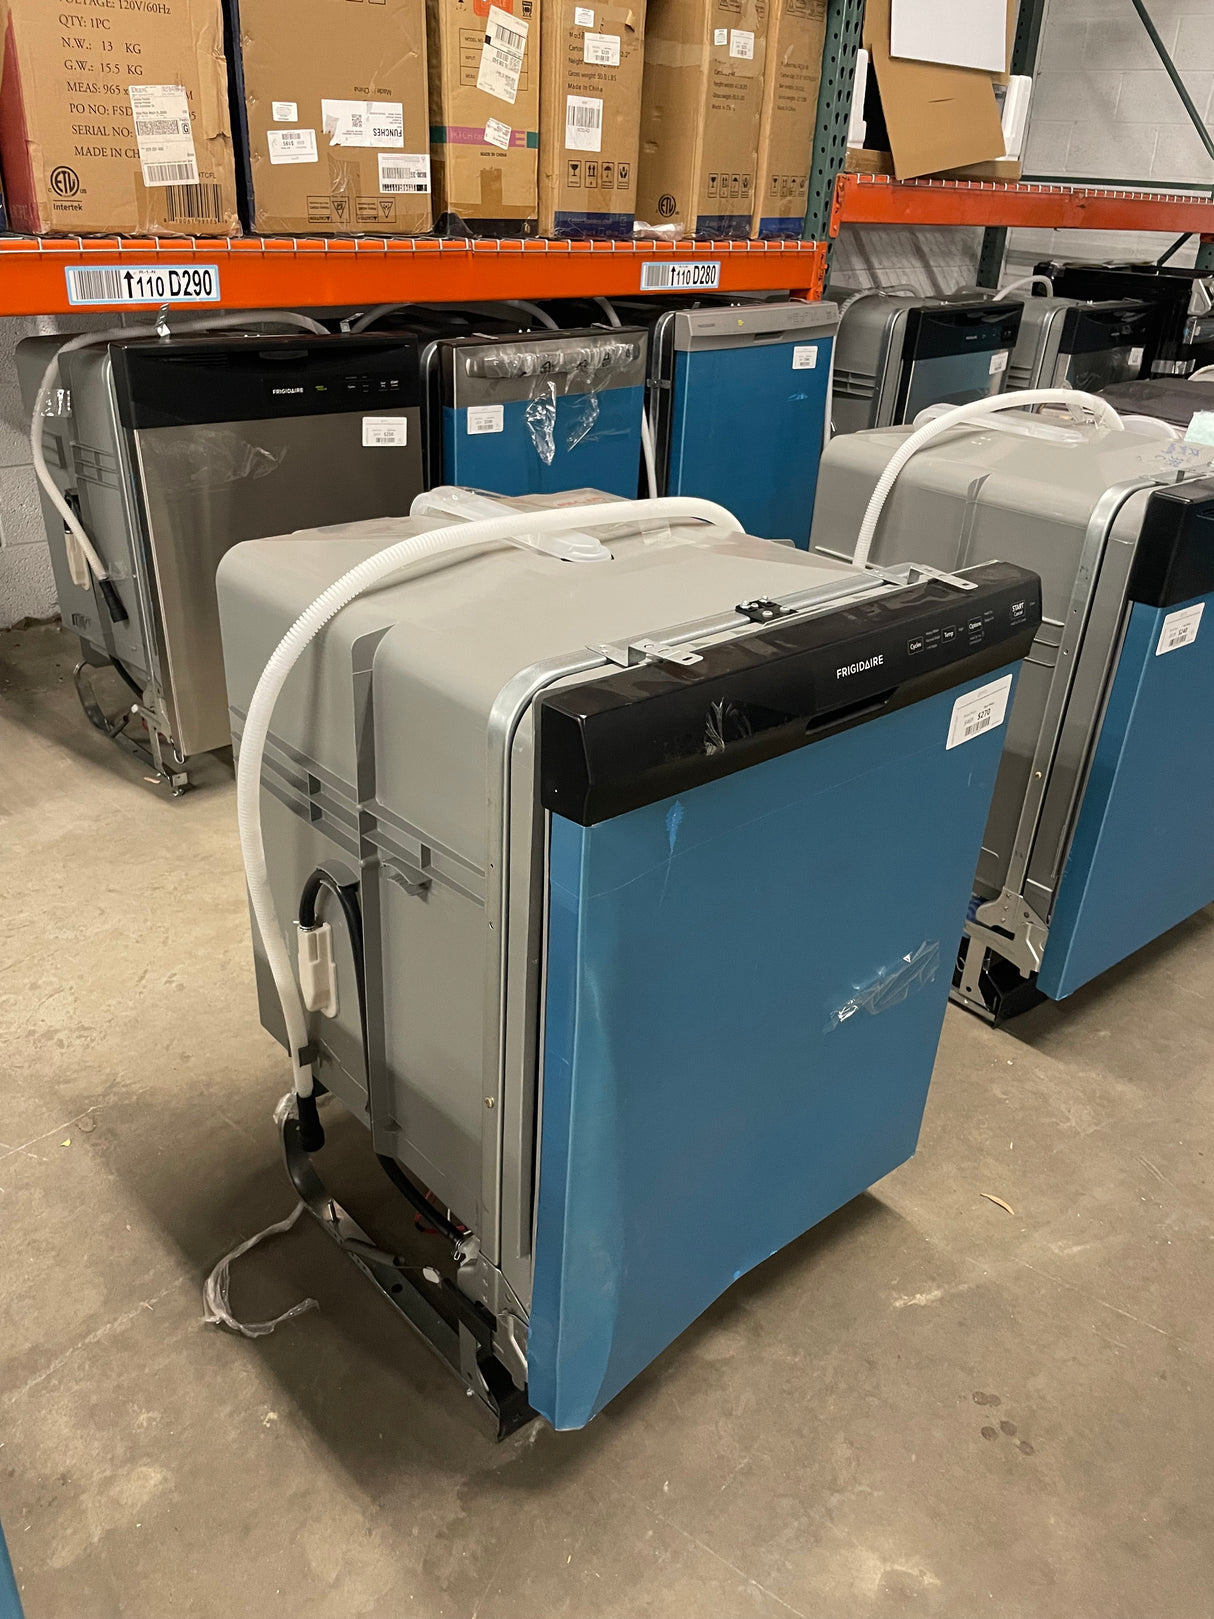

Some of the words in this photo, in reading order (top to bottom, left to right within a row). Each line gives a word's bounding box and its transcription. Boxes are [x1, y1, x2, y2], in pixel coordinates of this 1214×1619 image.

[119, 0, 171, 15] 120V/60Hz
[58, 13, 87, 29] QTY:
[90, 17, 111, 30] 1PC
[61, 36, 92, 50] N.W.:
[102, 41, 113, 52] 13
[125, 43, 141, 55] KG
[64, 59, 93, 71] G.W.:
[100, 62, 120, 74] 15.5
[127, 64, 143, 76] KG
[66, 81, 101, 94] MEAS:
[103, 84, 120, 95] 965
[377, 88, 392, 96] Made
[567, 82, 581, 90] Made
[69, 103, 85, 114] PO
[88, 104, 109, 116] NO:
[71, 124, 110, 137] SERIAL
[112, 126, 133, 138] NO:
[183, 124, 189, 133] G
[373, 128, 402, 137] FUNCHES
[74, 146, 108, 157] MADE
[110, 147, 122, 158] IN
[53, 203, 83, 211] Intertek
[676, 270, 691, 285] 110
[693, 265, 716, 285] D280
[137, 276, 165, 297] 110
[168, 269, 213, 297] D290
[272, 387, 304, 395] FRIGIDAIRE
[836, 654, 884, 680] FRIGIDAIRE
[977, 708, 991, 721] $270
